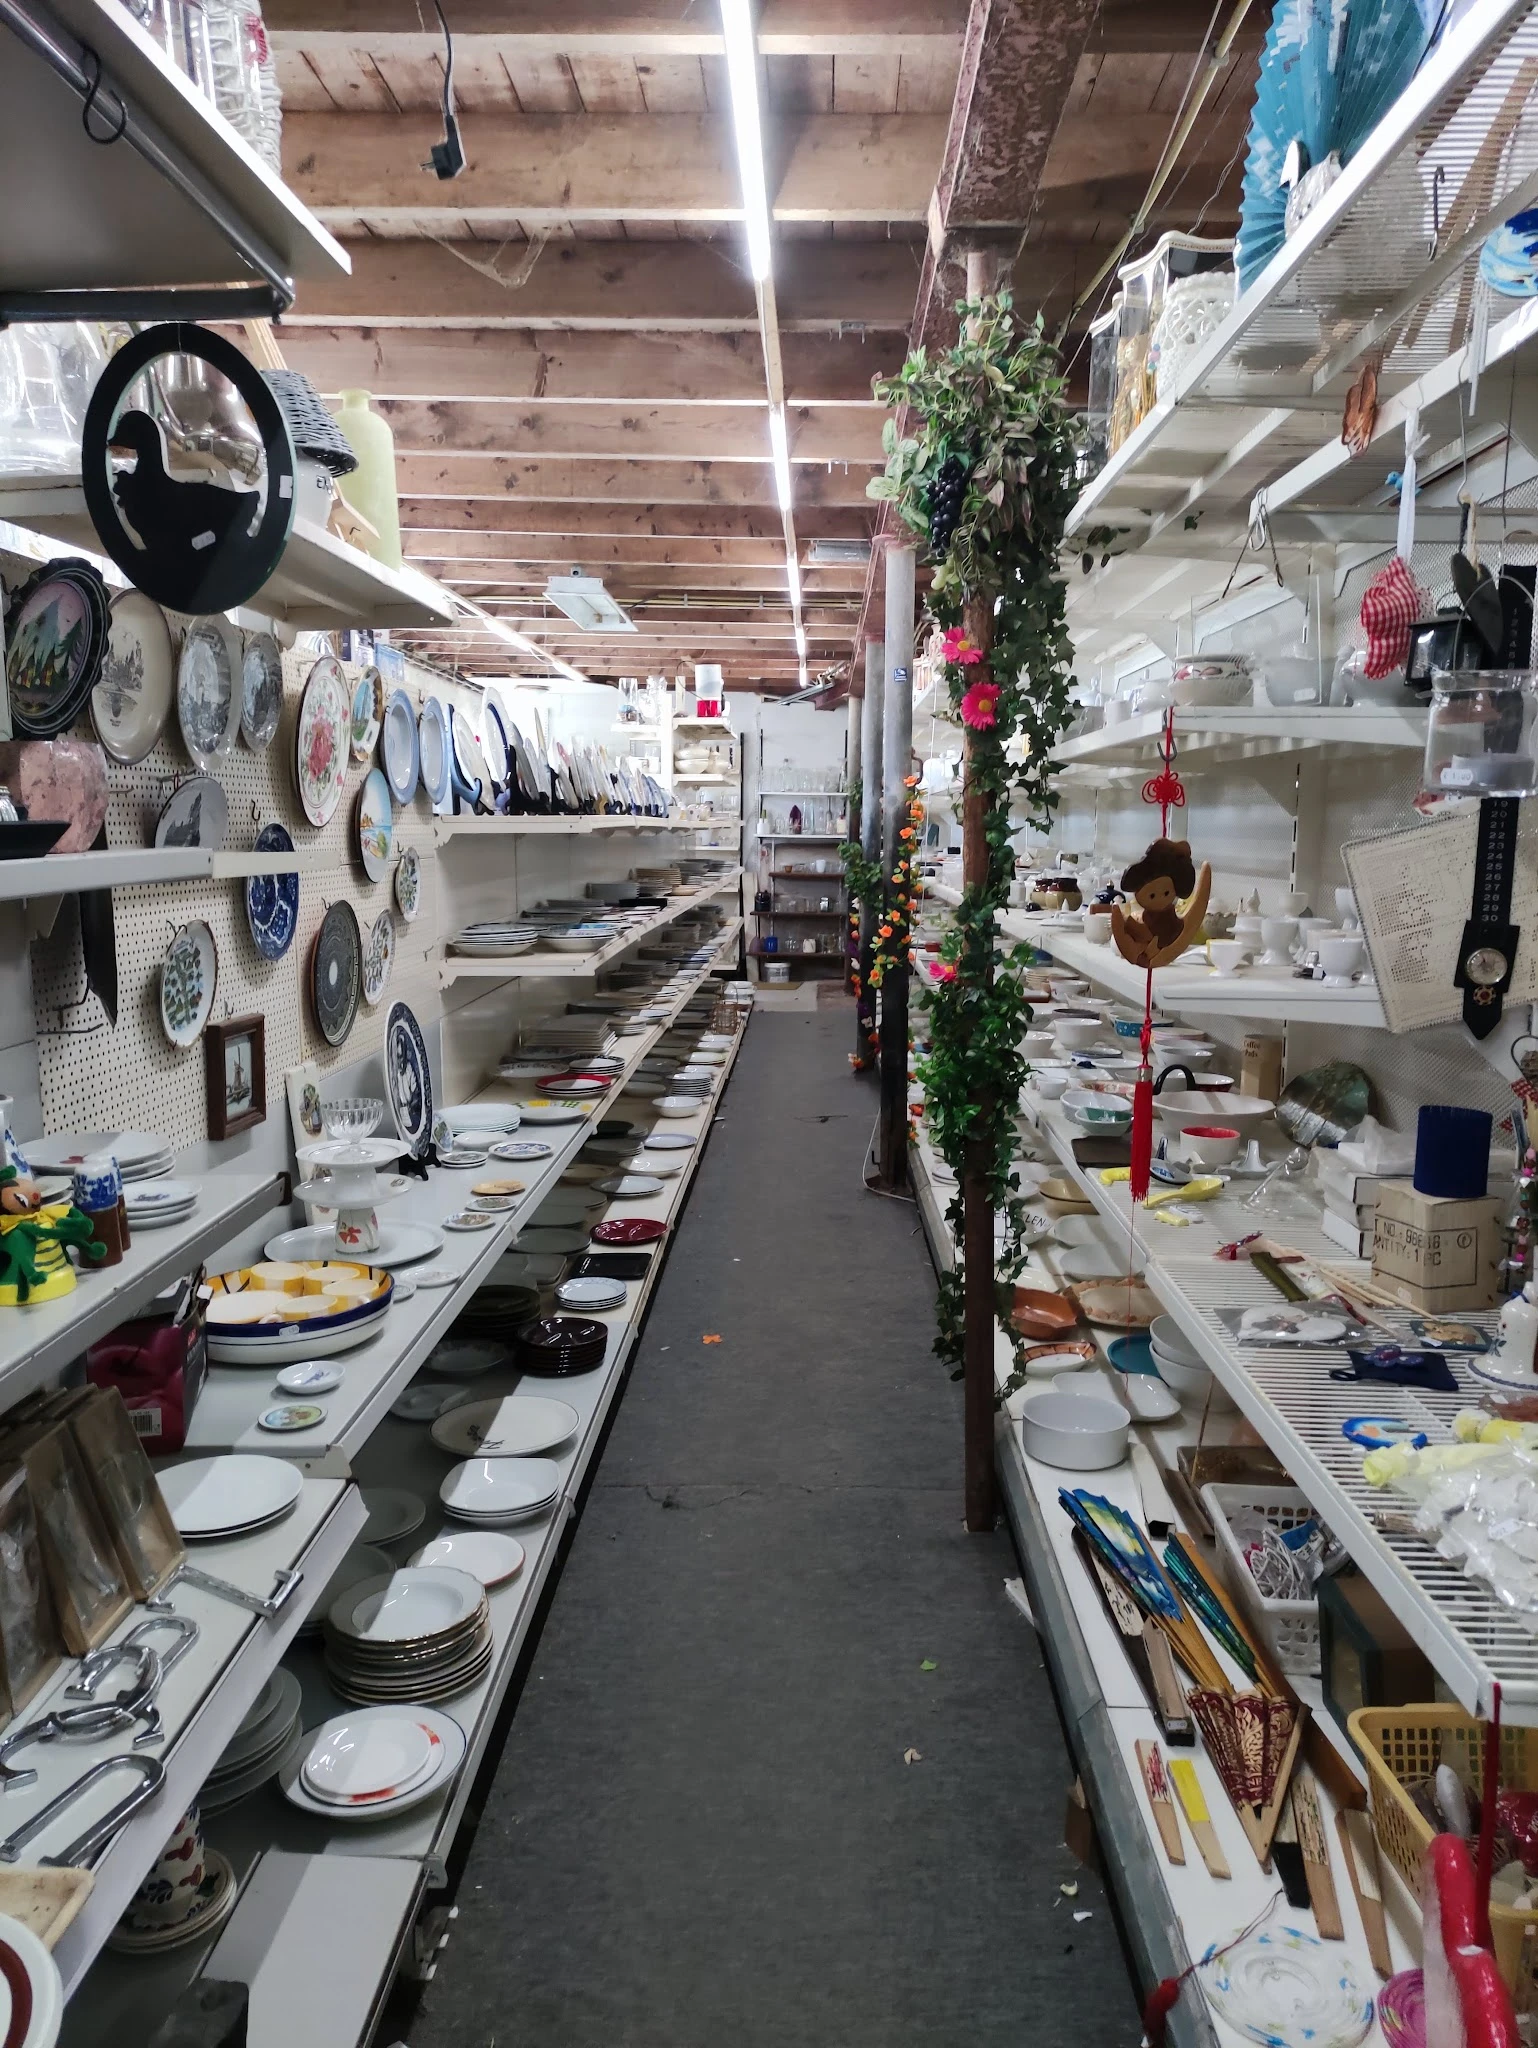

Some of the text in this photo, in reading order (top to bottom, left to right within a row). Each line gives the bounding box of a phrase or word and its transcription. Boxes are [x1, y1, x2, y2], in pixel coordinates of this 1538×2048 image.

[1492, 800, 1509, 808] 19
[1491, 810, 1508, 818] 20
[1490, 821, 1506, 829] 21
[1489, 831, 1506, 839] 22
[1488, 842, 1505, 850] 23
[1487, 852, 1503, 860] 24
[1485, 873, 1502, 881] 26
[1484, 883, 1501, 891] 27
[1481, 914, 1498, 922] 30
